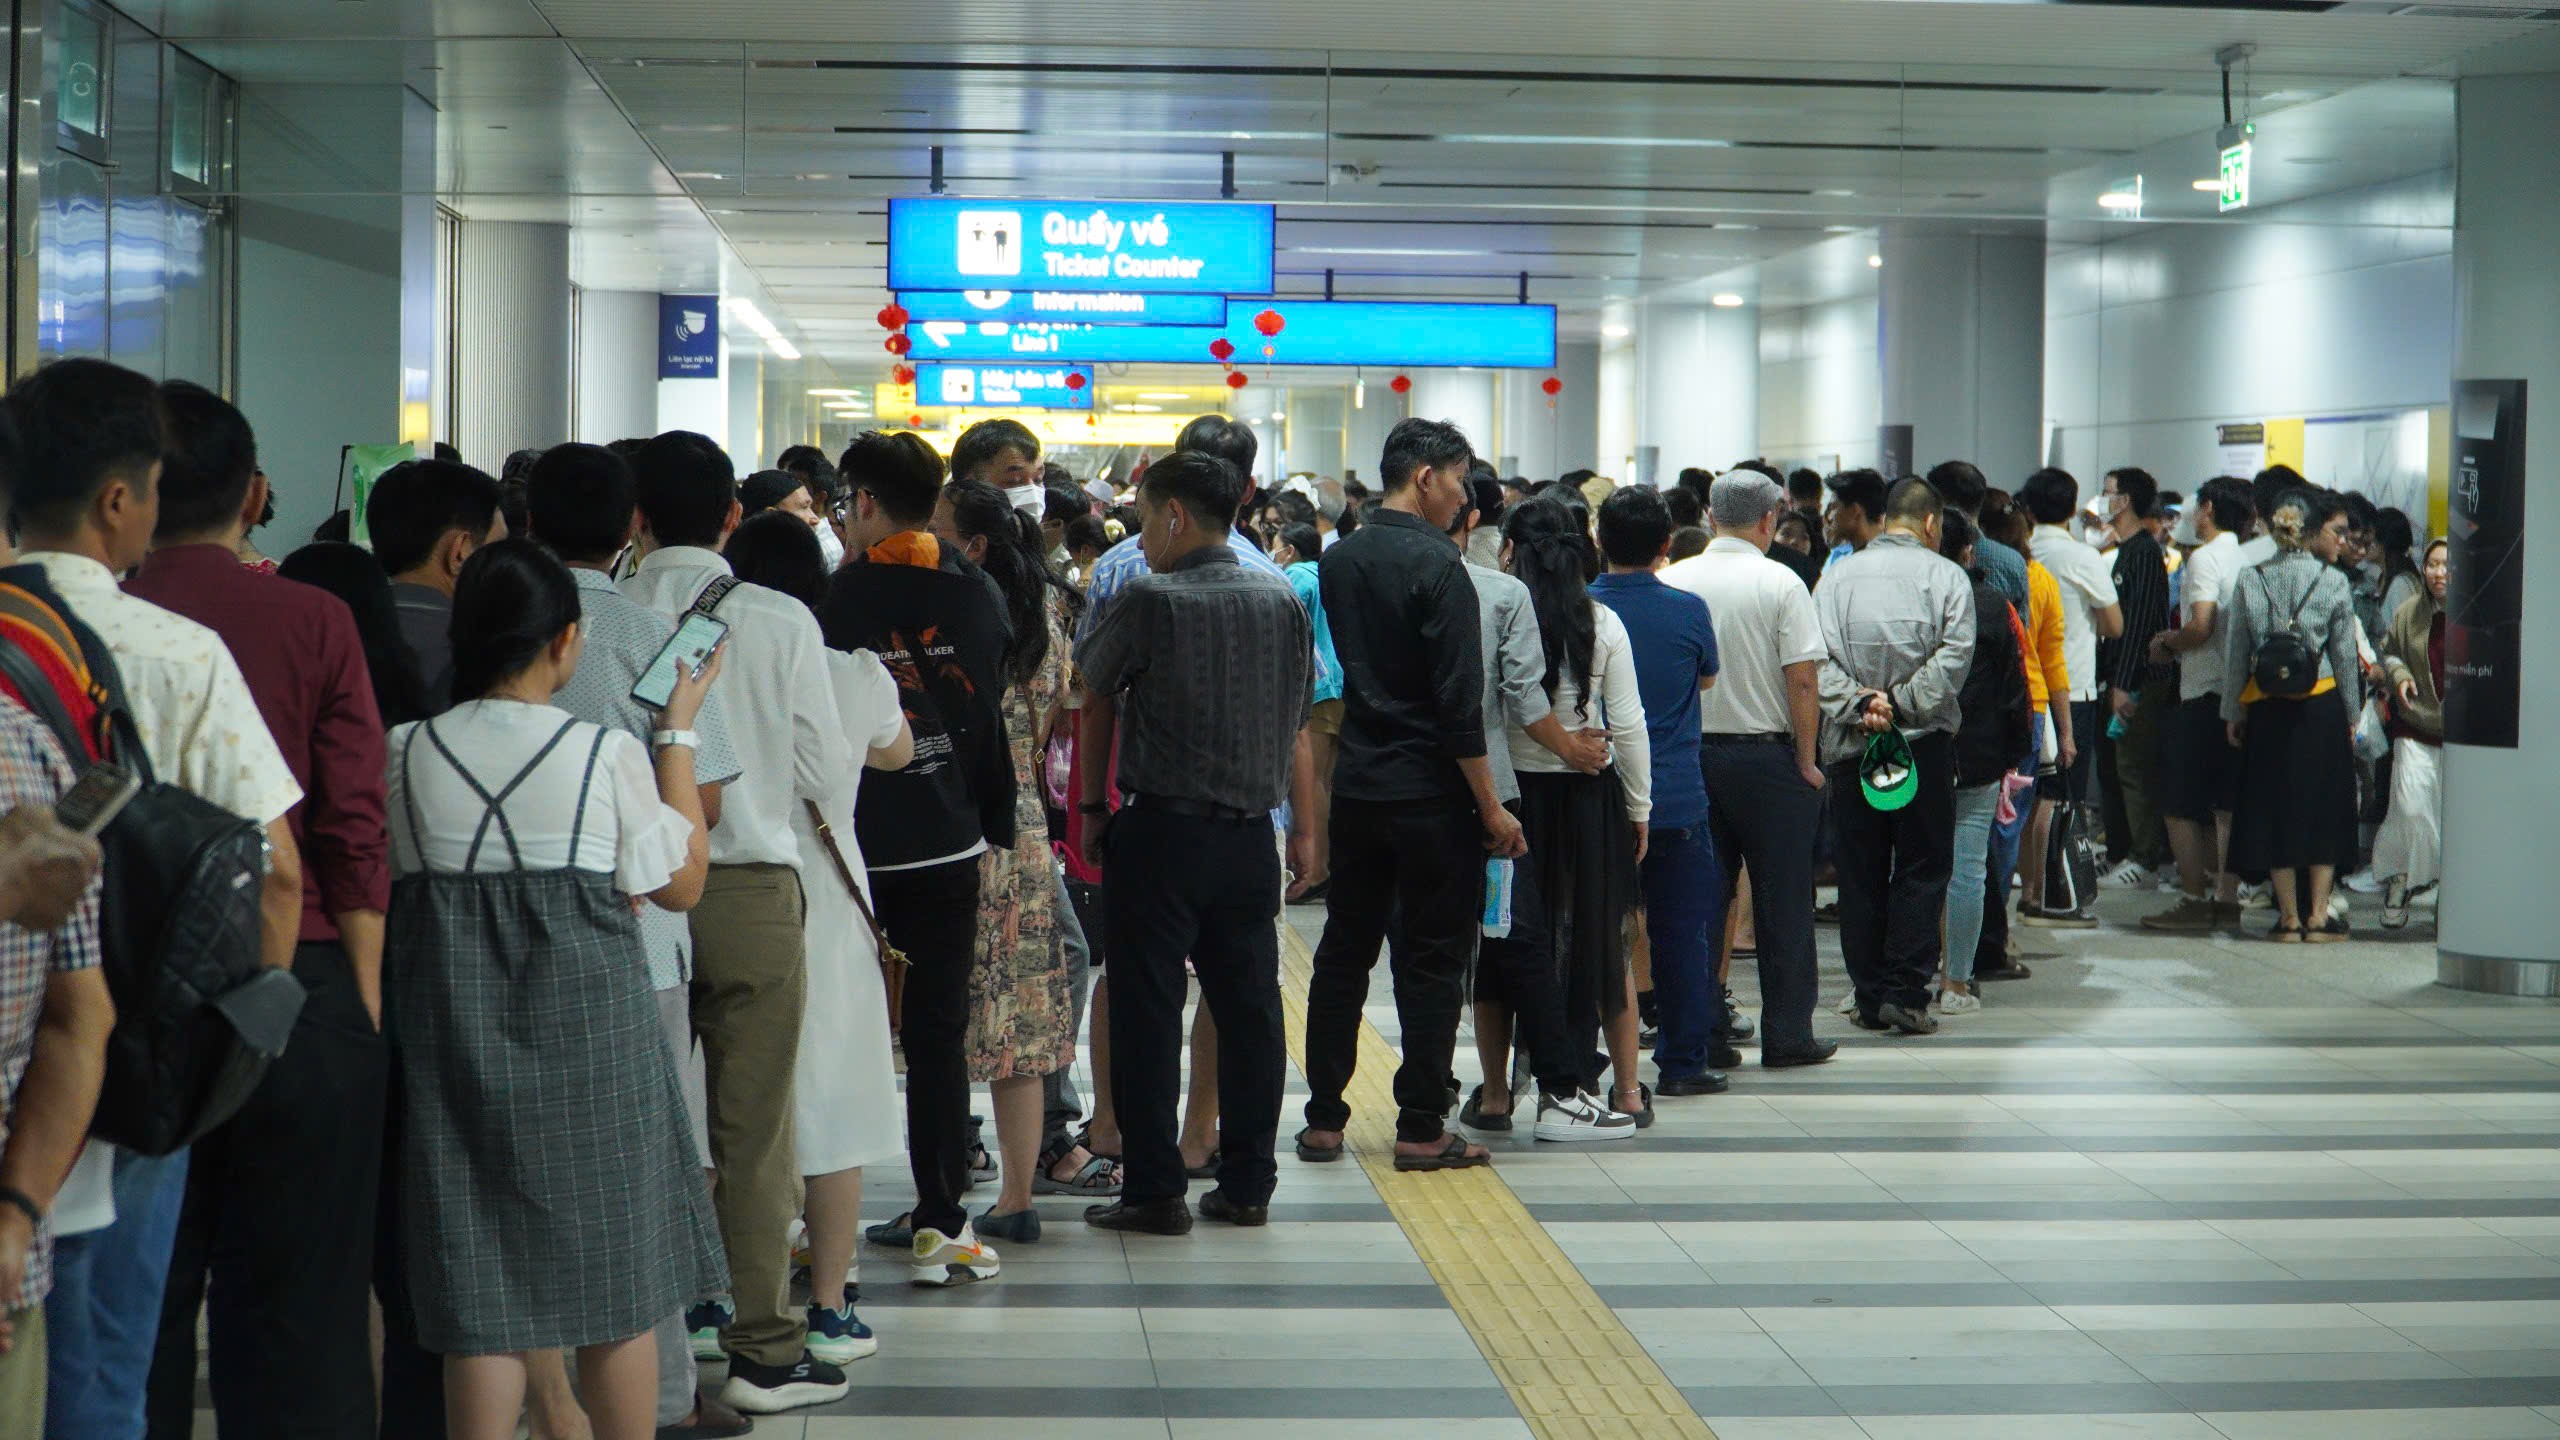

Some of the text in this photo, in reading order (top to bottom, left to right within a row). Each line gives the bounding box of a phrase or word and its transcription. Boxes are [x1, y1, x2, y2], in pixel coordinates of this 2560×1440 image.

[1131, 213, 1169, 246] vé
[1044, 252, 1204, 278] Ticket Counter
[1033, 291, 1145, 312] Information
[1012, 334, 1048, 352] Line
